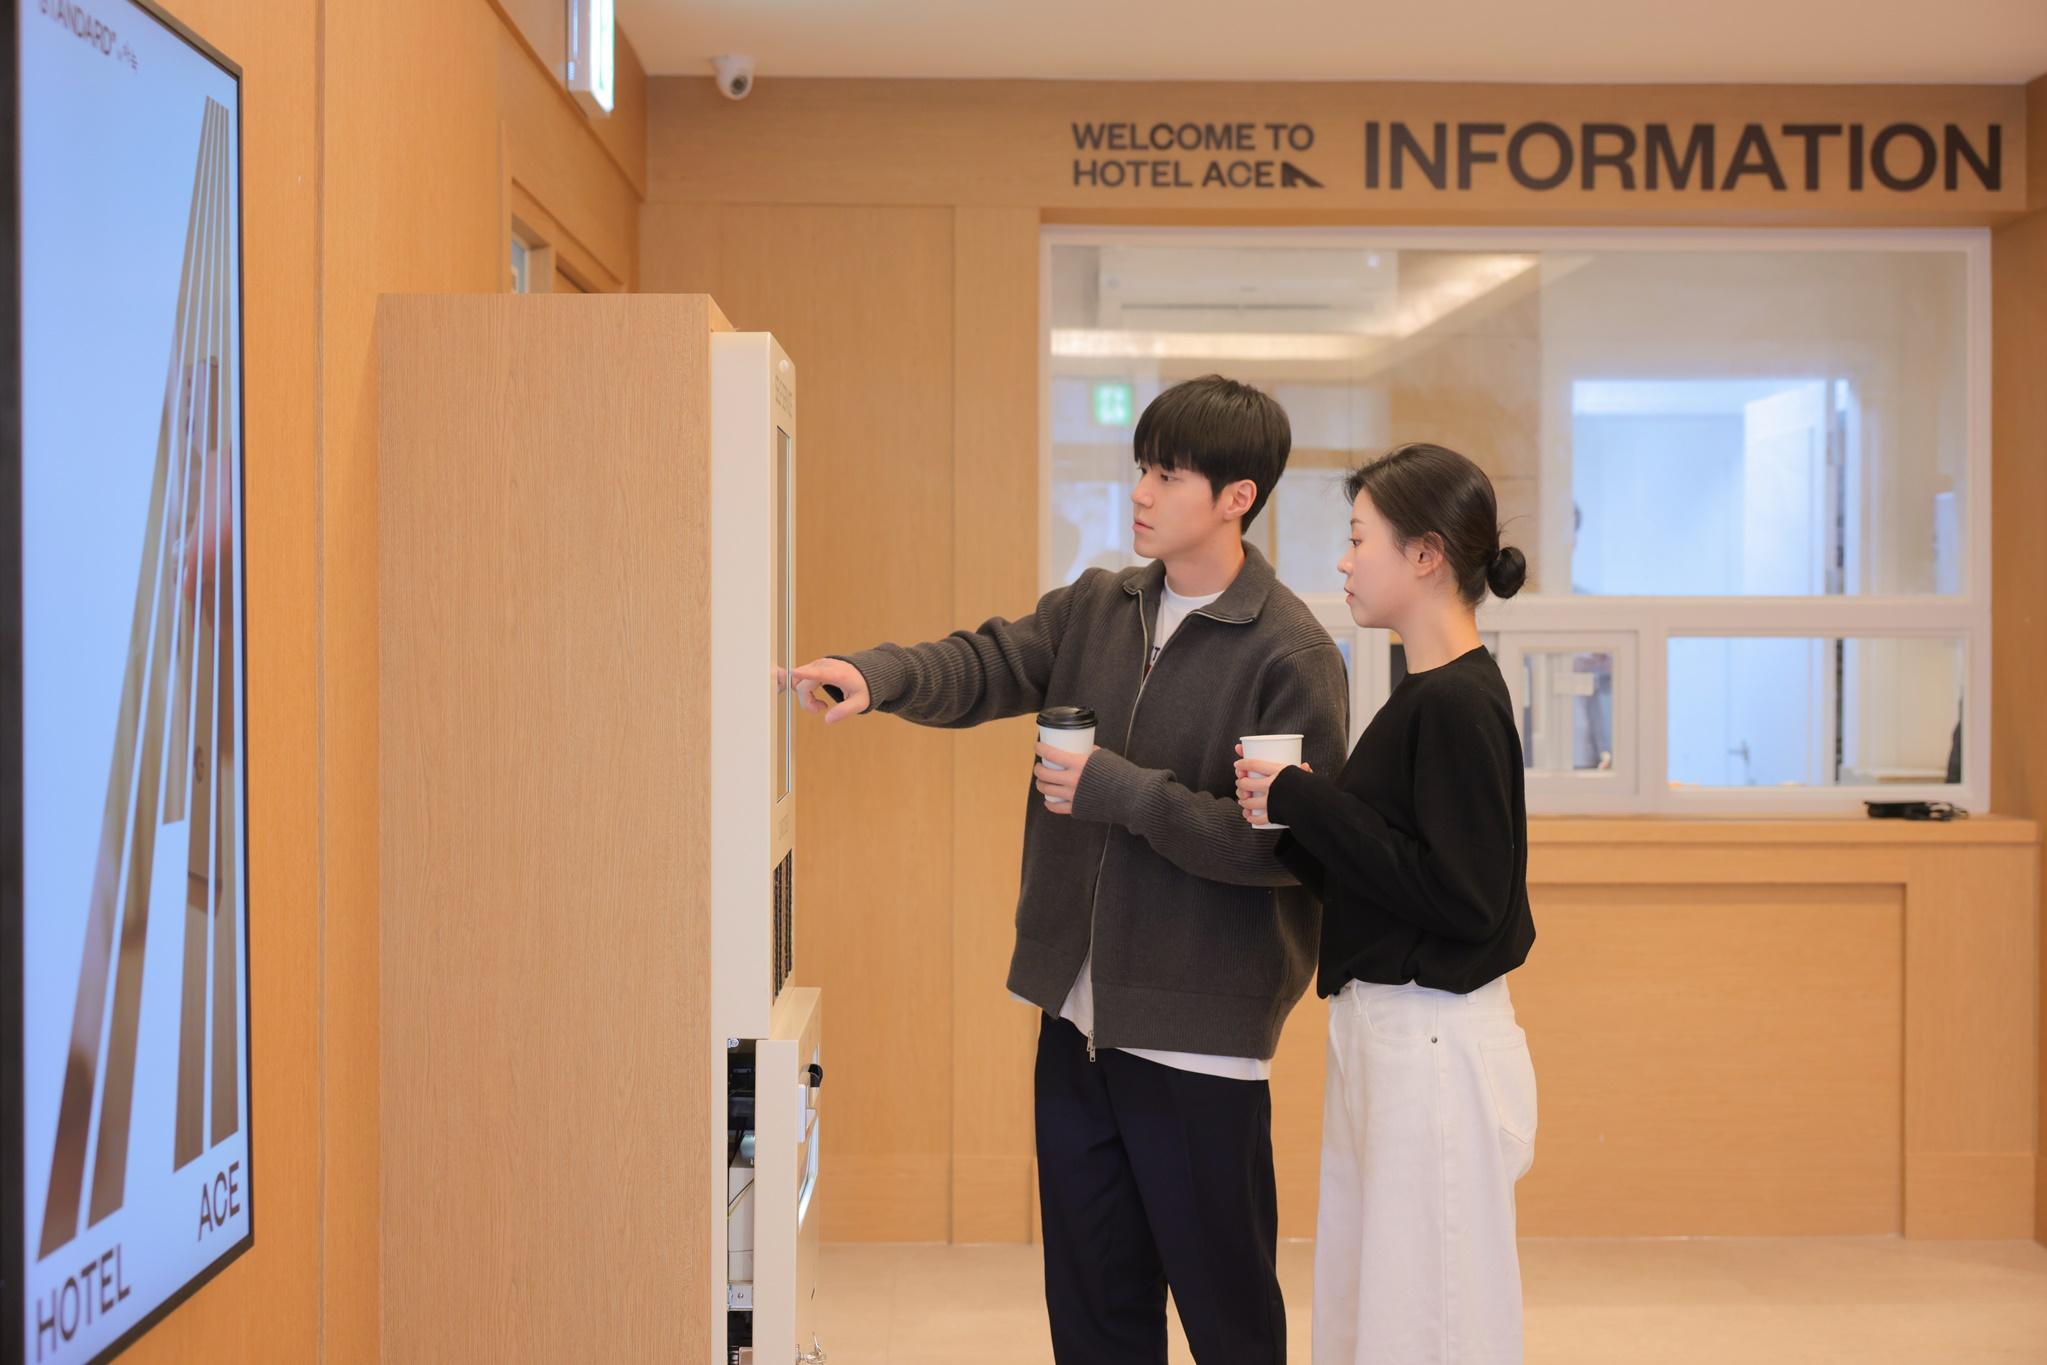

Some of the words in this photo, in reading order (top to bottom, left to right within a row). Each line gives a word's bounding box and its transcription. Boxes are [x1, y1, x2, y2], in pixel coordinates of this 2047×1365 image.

[1071, 122, 1256, 151] WELCOME
[1264, 122, 1315, 152] TO
[1365, 121, 2004, 192] INFORMATION
[1073, 159, 1193, 188] HOTEL
[1201, 160, 1275, 189] ACE
[198, 1160, 241, 1242] ACE
[36, 1243, 130, 1364] HOTEL
